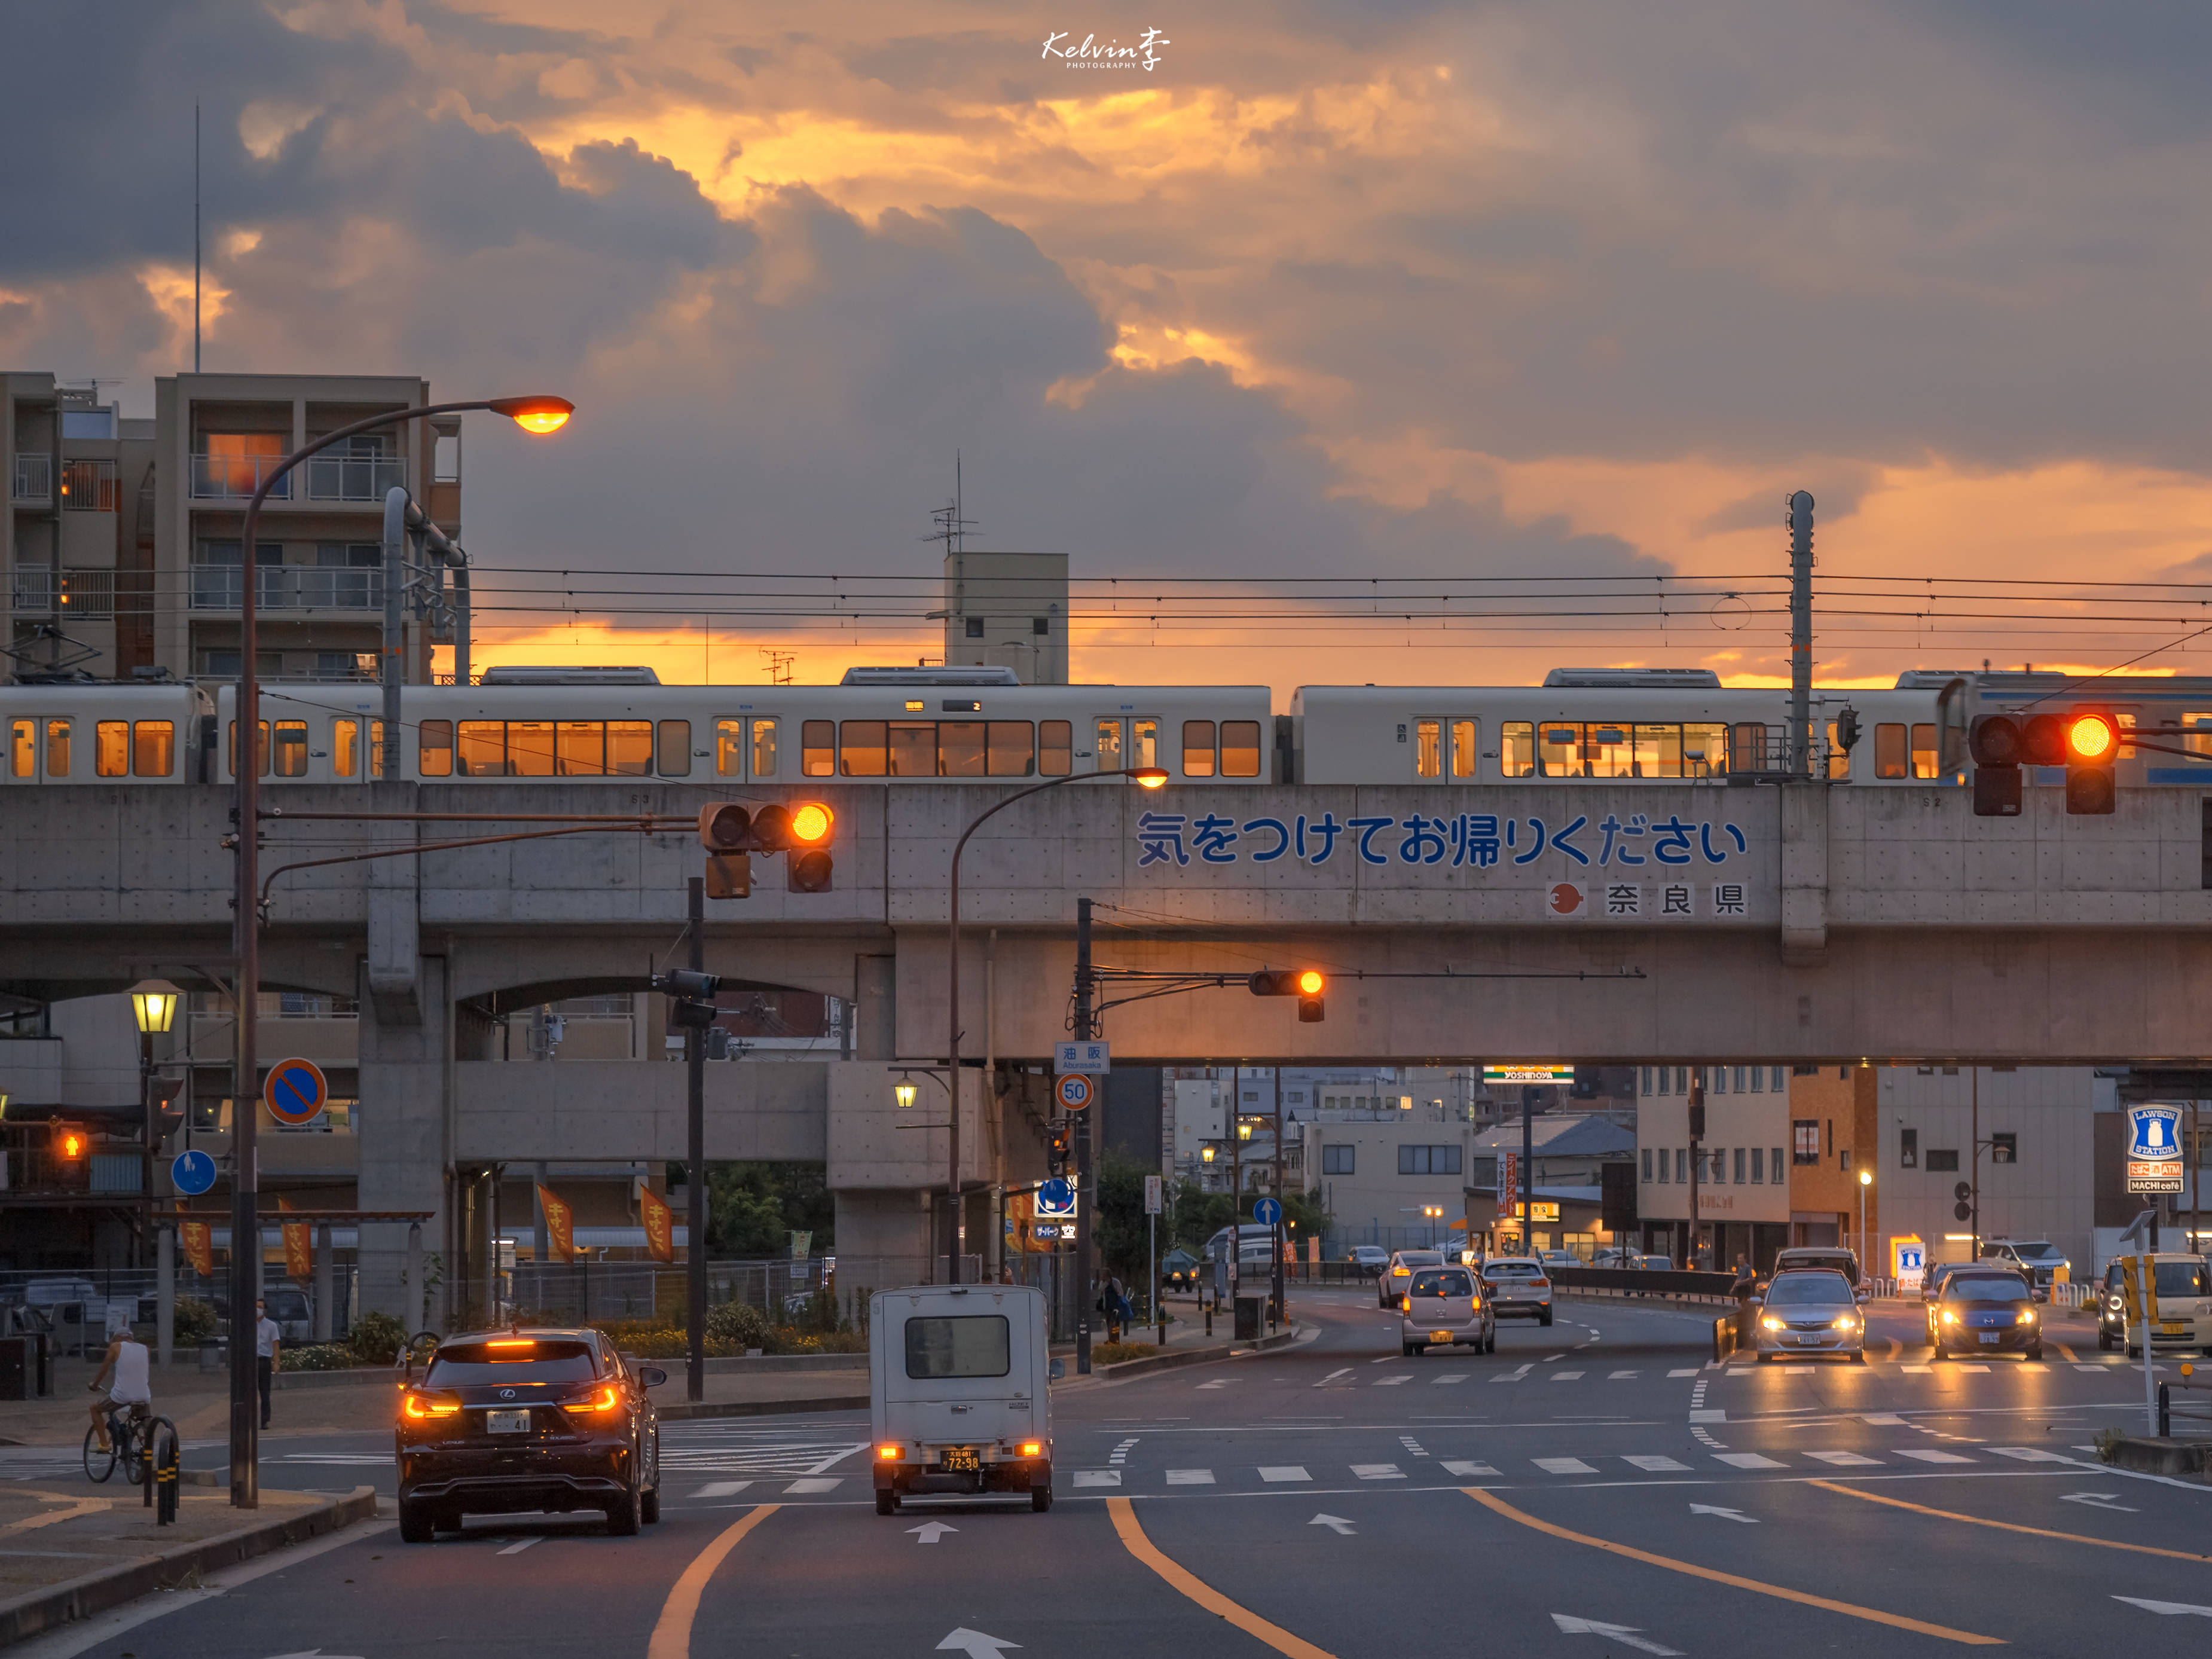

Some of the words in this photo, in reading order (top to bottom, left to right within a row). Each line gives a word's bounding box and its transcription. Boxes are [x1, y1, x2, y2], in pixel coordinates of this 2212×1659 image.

[1139, 812, 1746, 869] 気をつけてお帰りください
[1609, 884, 1744, 914] 奈良県
[1064, 1047, 1101, 1060] 油阪
[1065, 1083, 1084, 1099] 50
[2134, 1110, 2176, 1120] LAWSON
[2135, 1144, 2176, 1155] STATION
[2162, 1165, 2181, 1175] ATM
[2131, 1181, 2160, 1190] MACHI
[2161, 1181, 2180, 1190] café
[949, 1458, 978, 1468] 72-98
